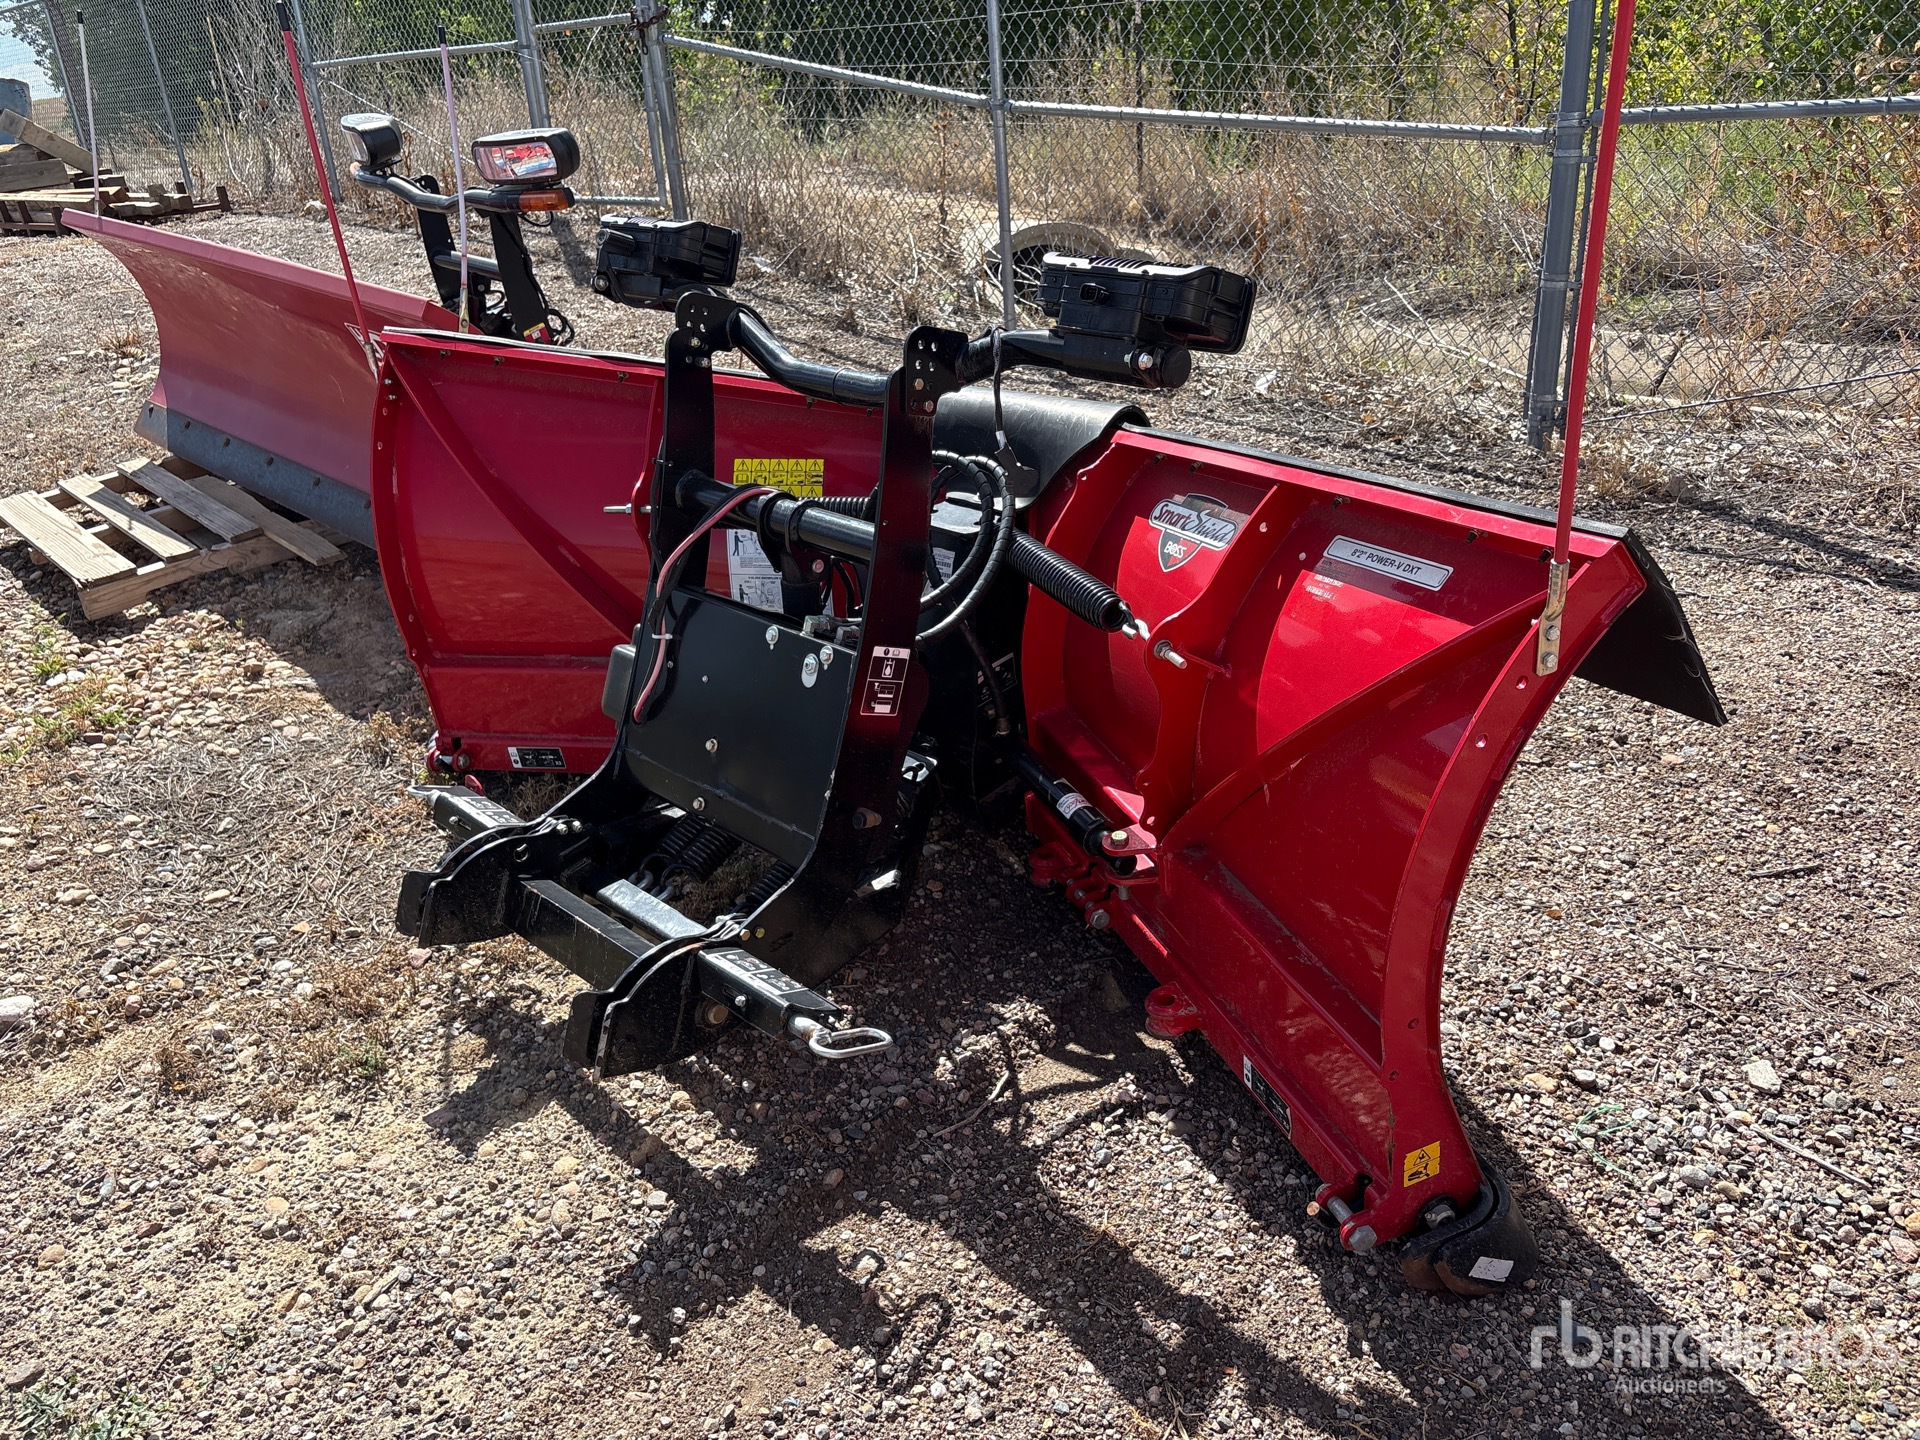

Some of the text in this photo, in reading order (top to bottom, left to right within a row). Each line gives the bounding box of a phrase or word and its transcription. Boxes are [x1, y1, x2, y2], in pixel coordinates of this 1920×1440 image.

[1163, 540, 1187, 559] BOSS
[1366, 553, 1404, 570] POWER-V
[1403, 564, 1422, 575] DXT
